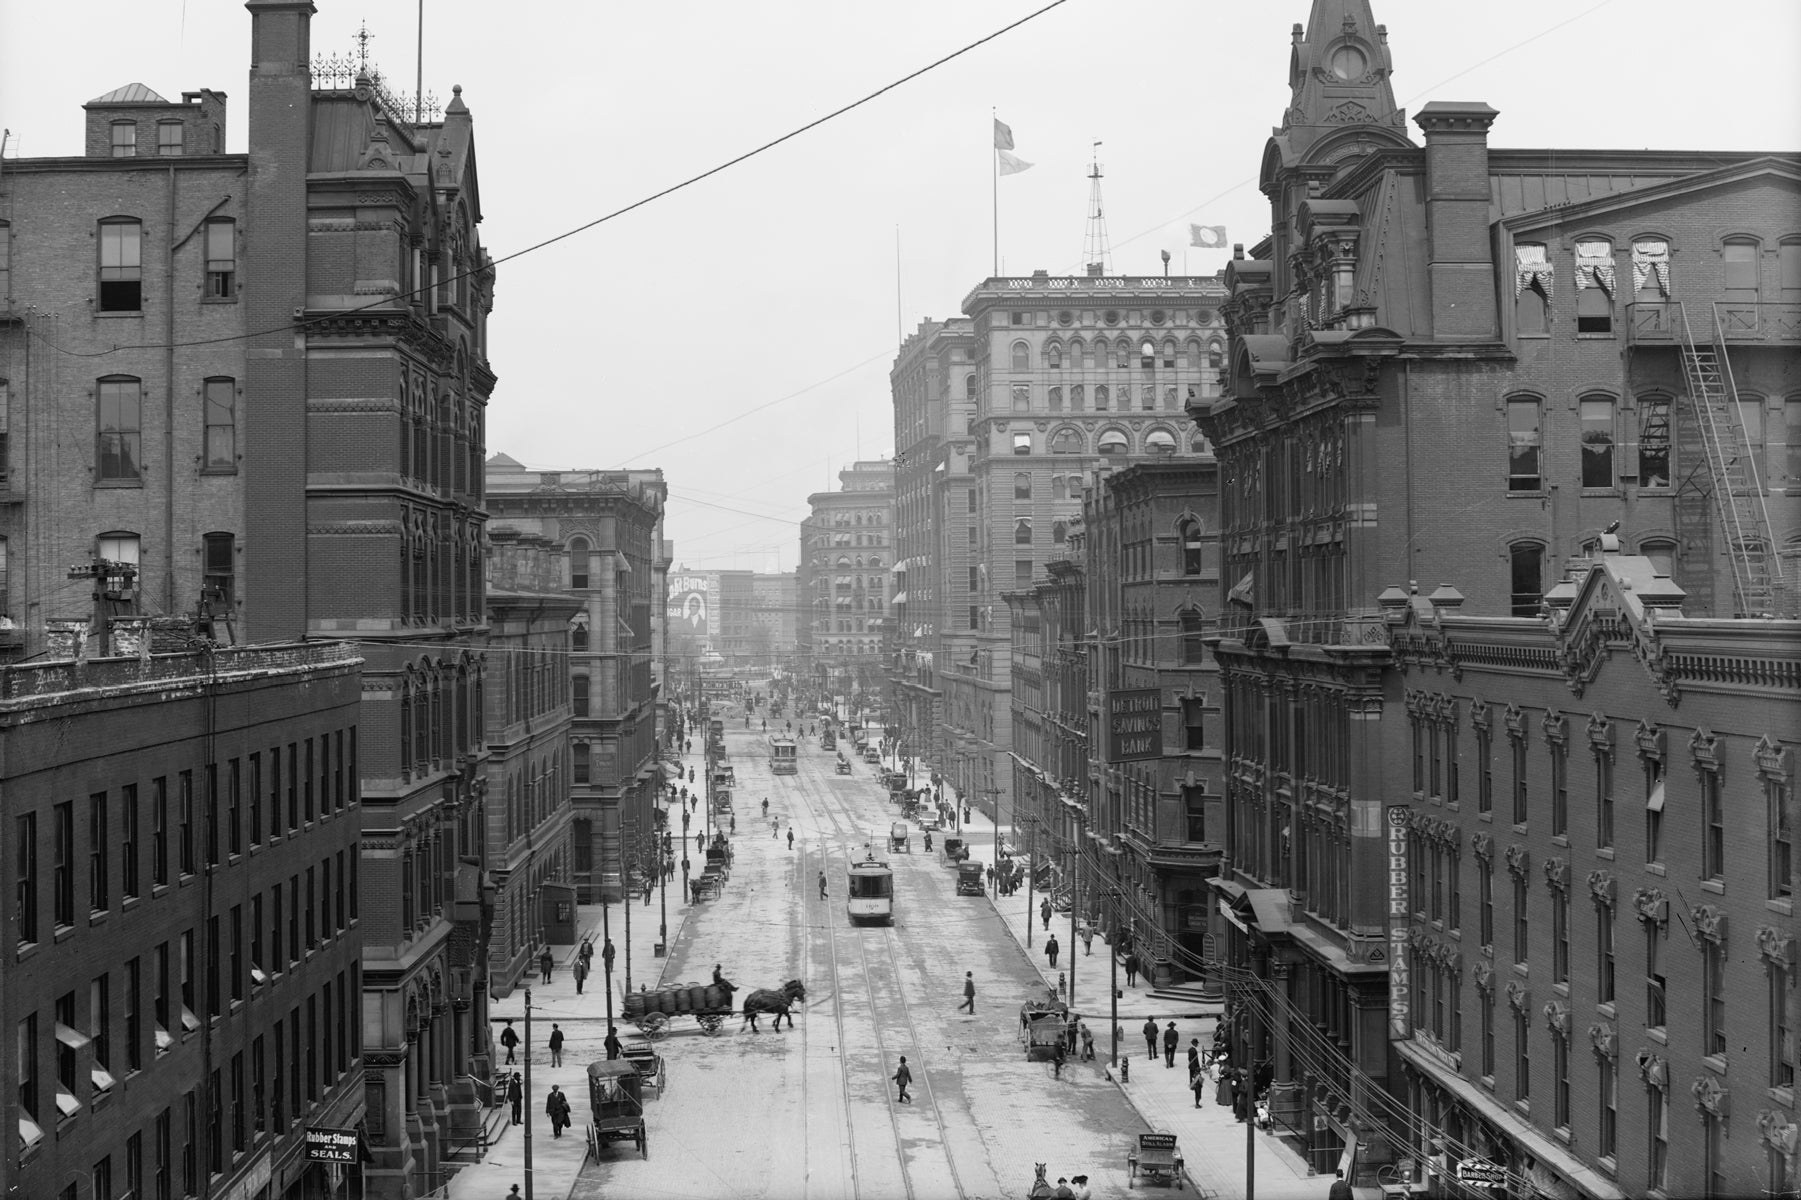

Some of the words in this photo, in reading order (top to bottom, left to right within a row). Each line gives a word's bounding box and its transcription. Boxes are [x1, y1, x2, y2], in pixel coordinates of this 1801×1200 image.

[683, 576, 707, 592] Burns
[1112, 695, 1160, 714] DETROIT
[1112, 716, 1161, 735] SAVINGS
[1121, 737, 1153, 755] BANK
[1389, 826, 1408, 914] RUBBER
[1390, 927, 1409, 1015] STAMPS
[306, 1131, 332, 1144] Rubber
[332, 1133, 356, 1148] Stamps
[310, 1149, 353, 1160] SEALS.
